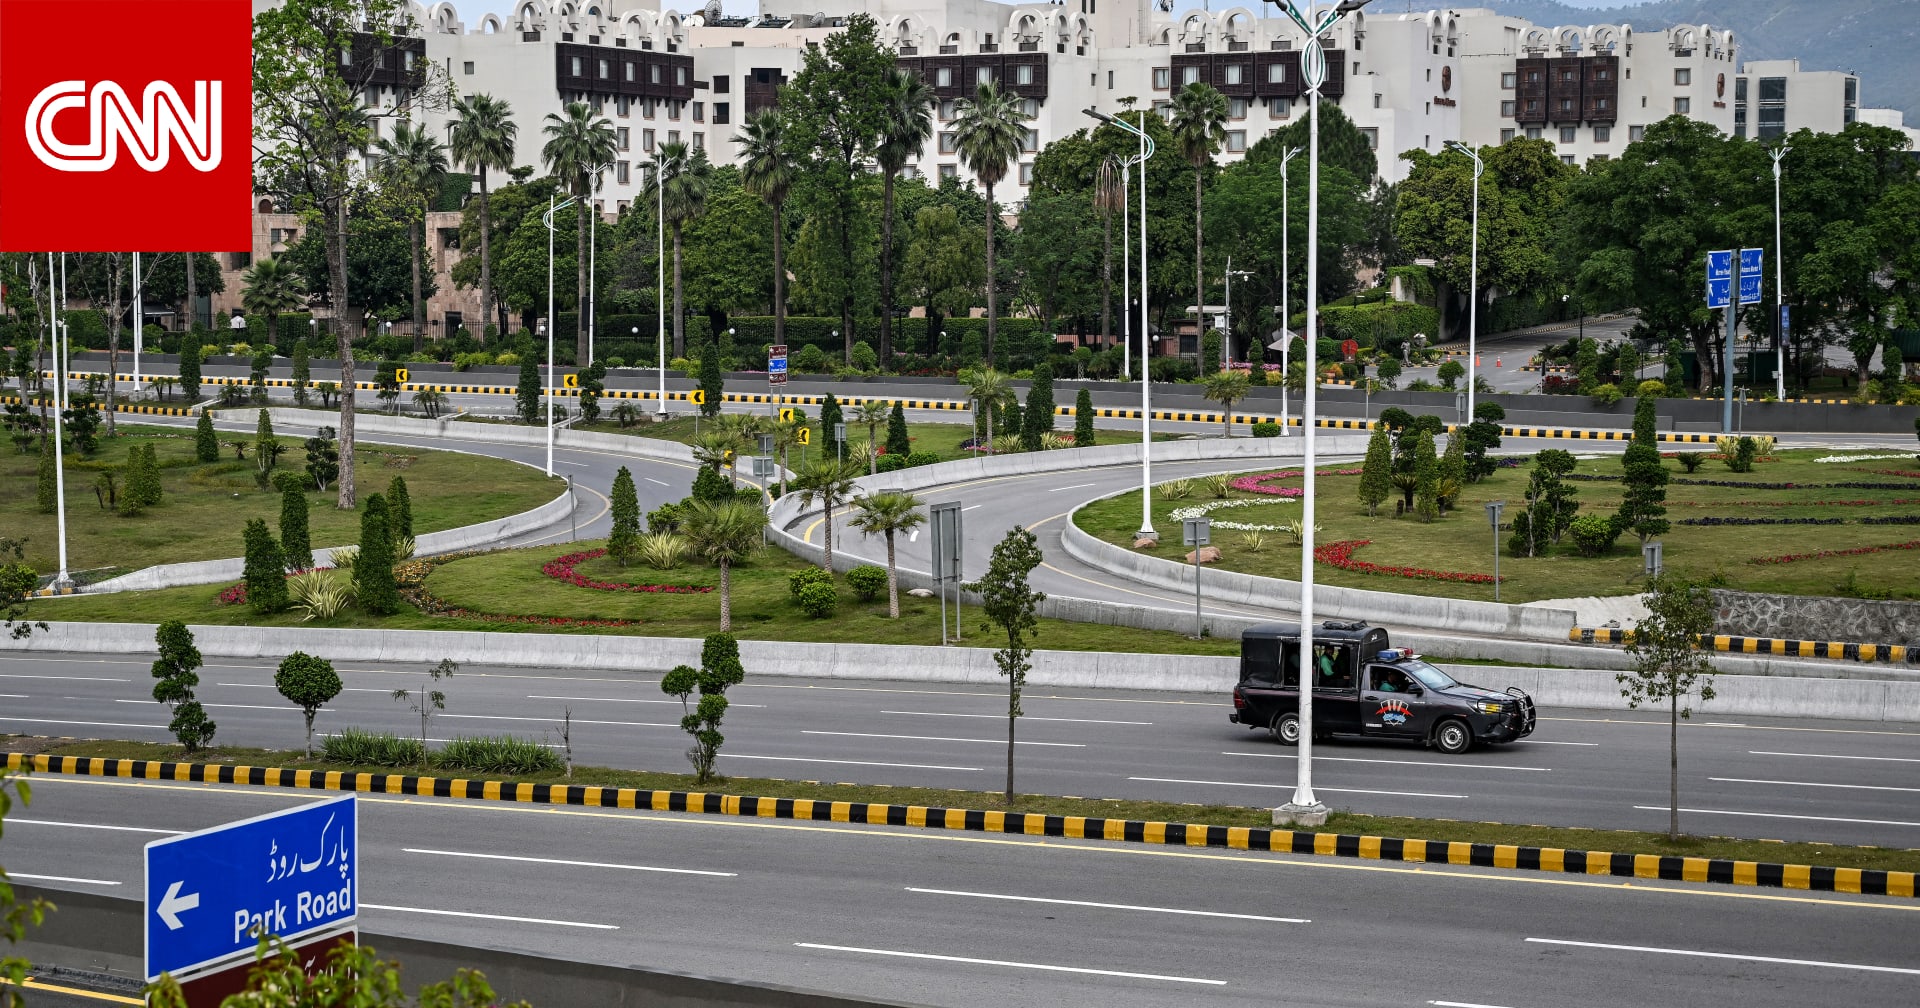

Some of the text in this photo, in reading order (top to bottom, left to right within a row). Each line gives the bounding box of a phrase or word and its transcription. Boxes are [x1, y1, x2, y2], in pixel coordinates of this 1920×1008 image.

[267, 812, 348, 883] پارک روڈ
[234, 878, 351, 944] Park Road
